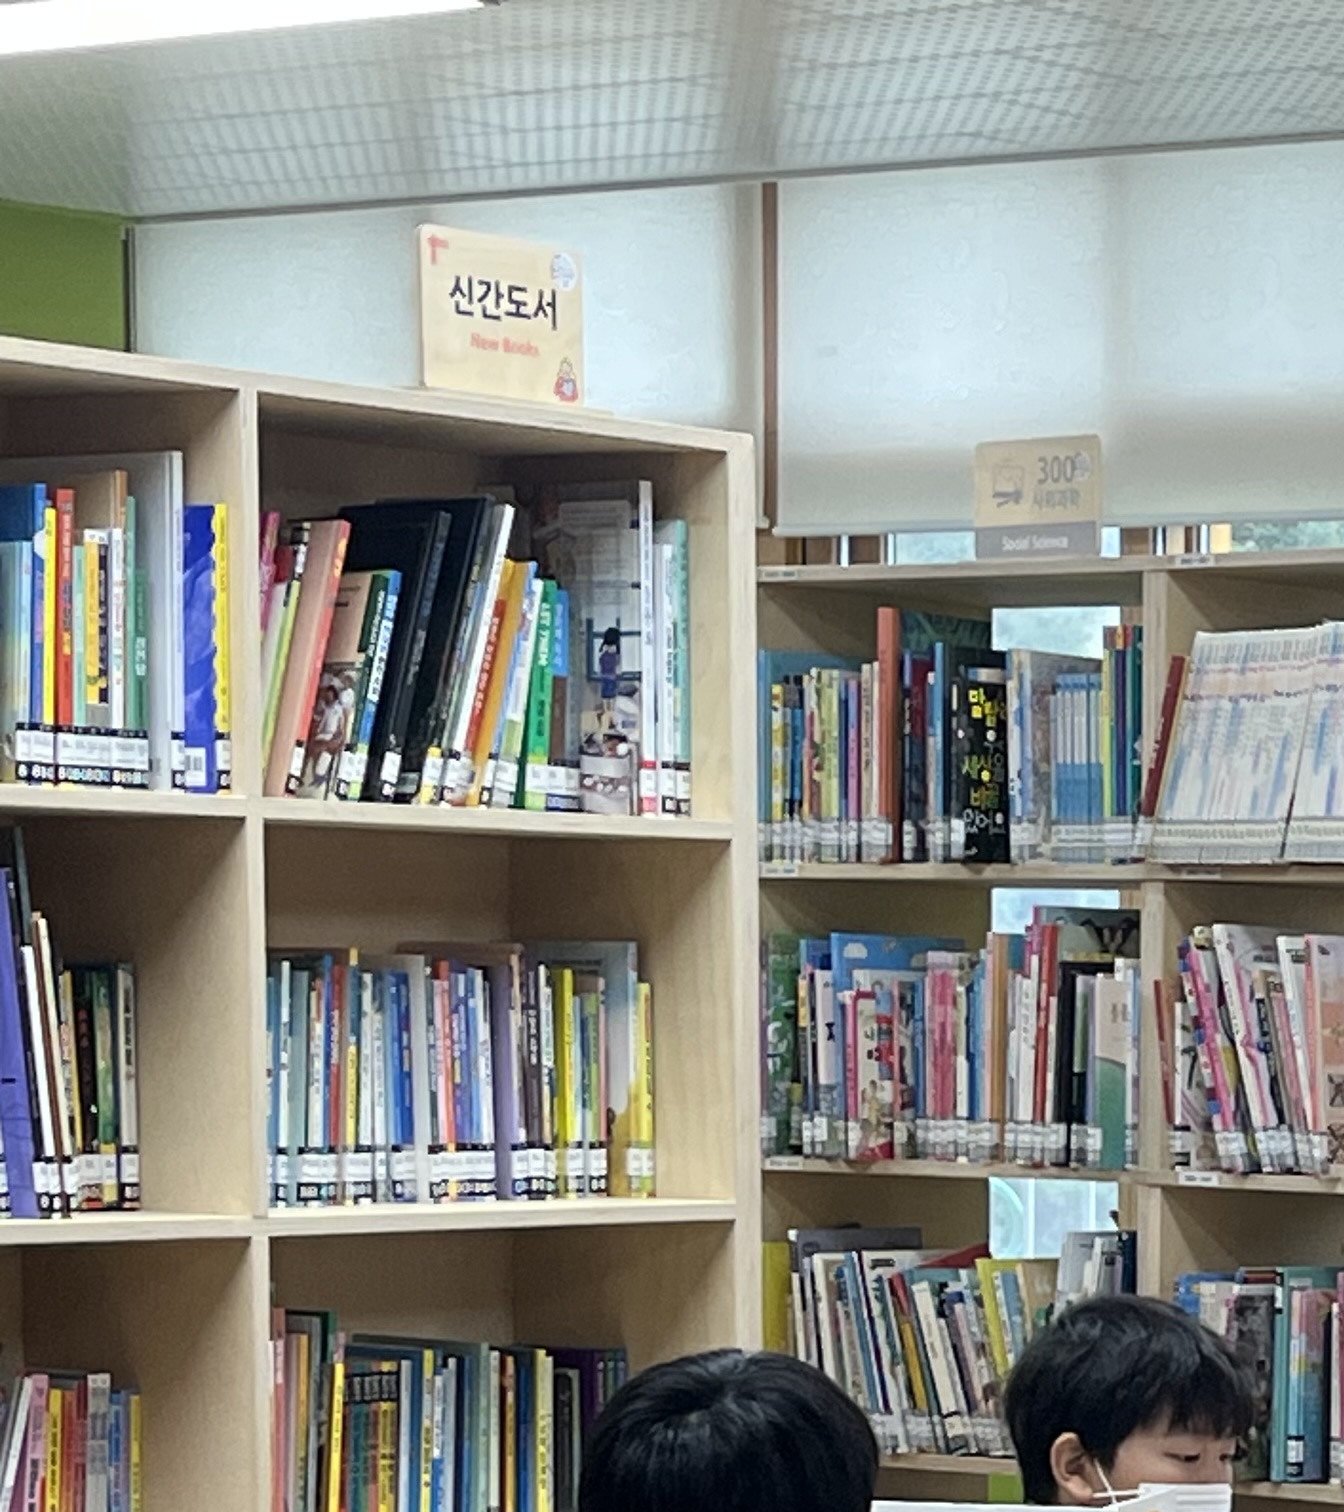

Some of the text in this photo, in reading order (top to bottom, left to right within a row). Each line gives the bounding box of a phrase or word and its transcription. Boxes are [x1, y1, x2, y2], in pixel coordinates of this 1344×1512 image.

[448, 274, 558, 331] 신간도서
[470, 332, 541, 357] New Books
[1036, 454, 1077, 485] 300
